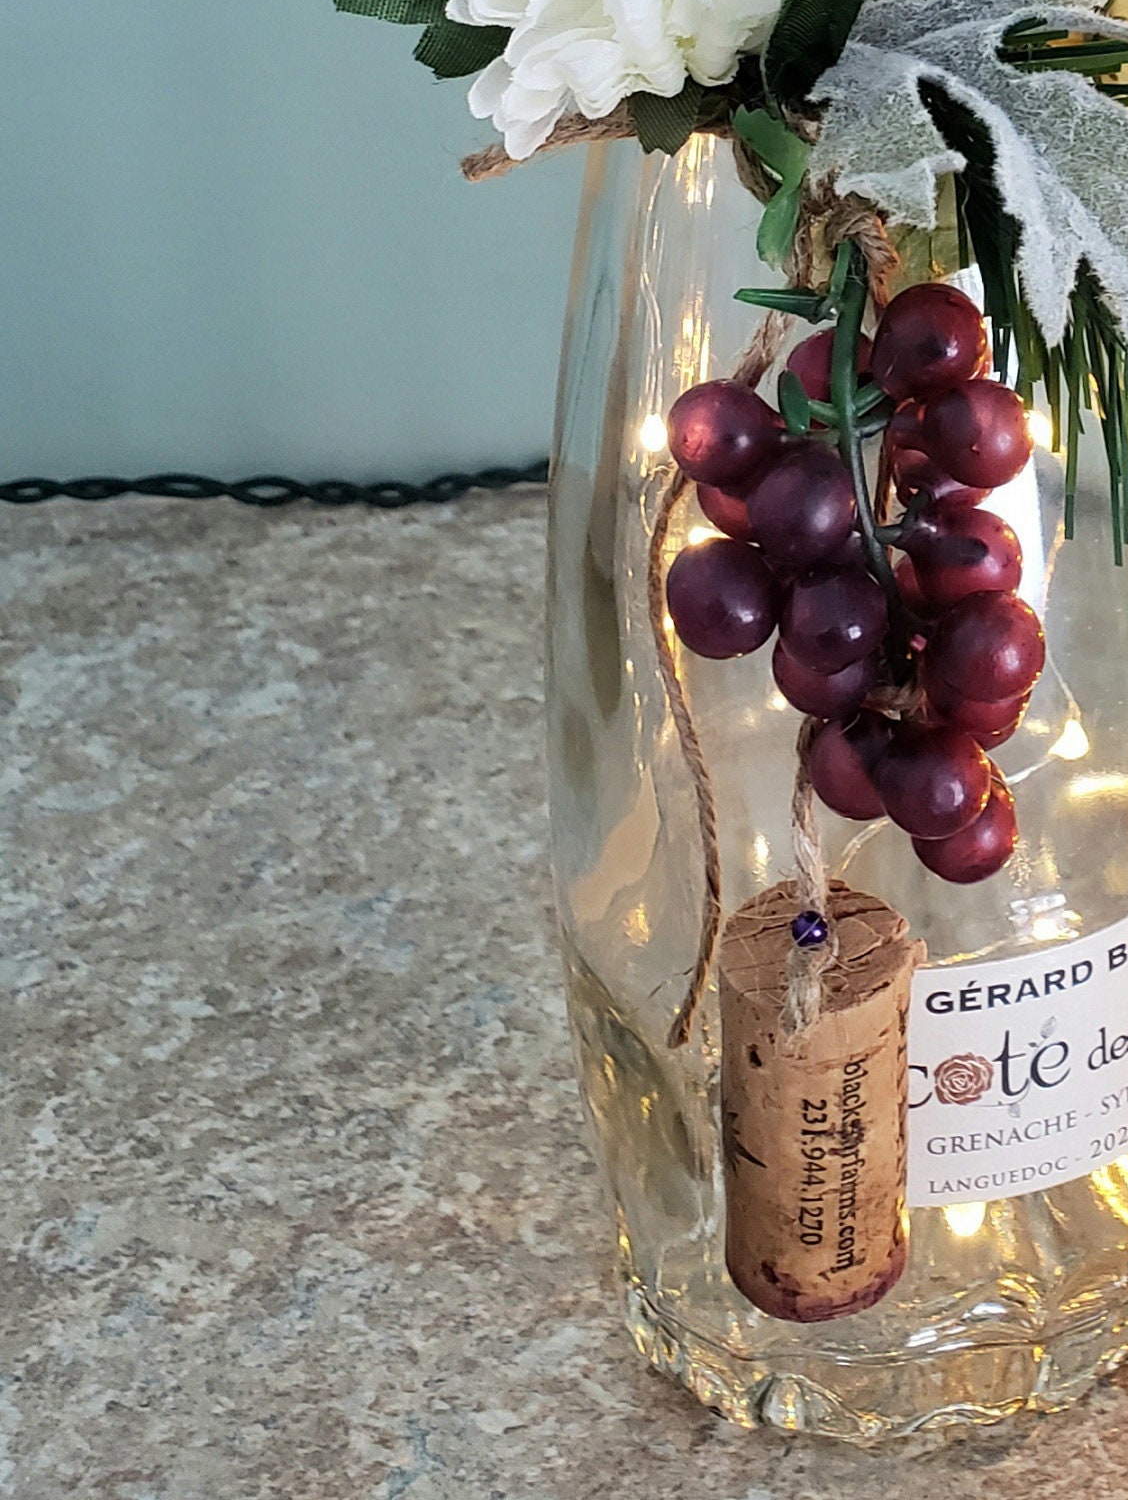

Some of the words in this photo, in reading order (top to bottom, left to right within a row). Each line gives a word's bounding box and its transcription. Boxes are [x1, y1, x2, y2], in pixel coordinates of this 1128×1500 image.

[925, 959, 1094, 1014] GÉRARD
[926, 1110, 1077, 1156] GRENACHE
[928, 1155, 1069, 1194] LANGUEDOC
